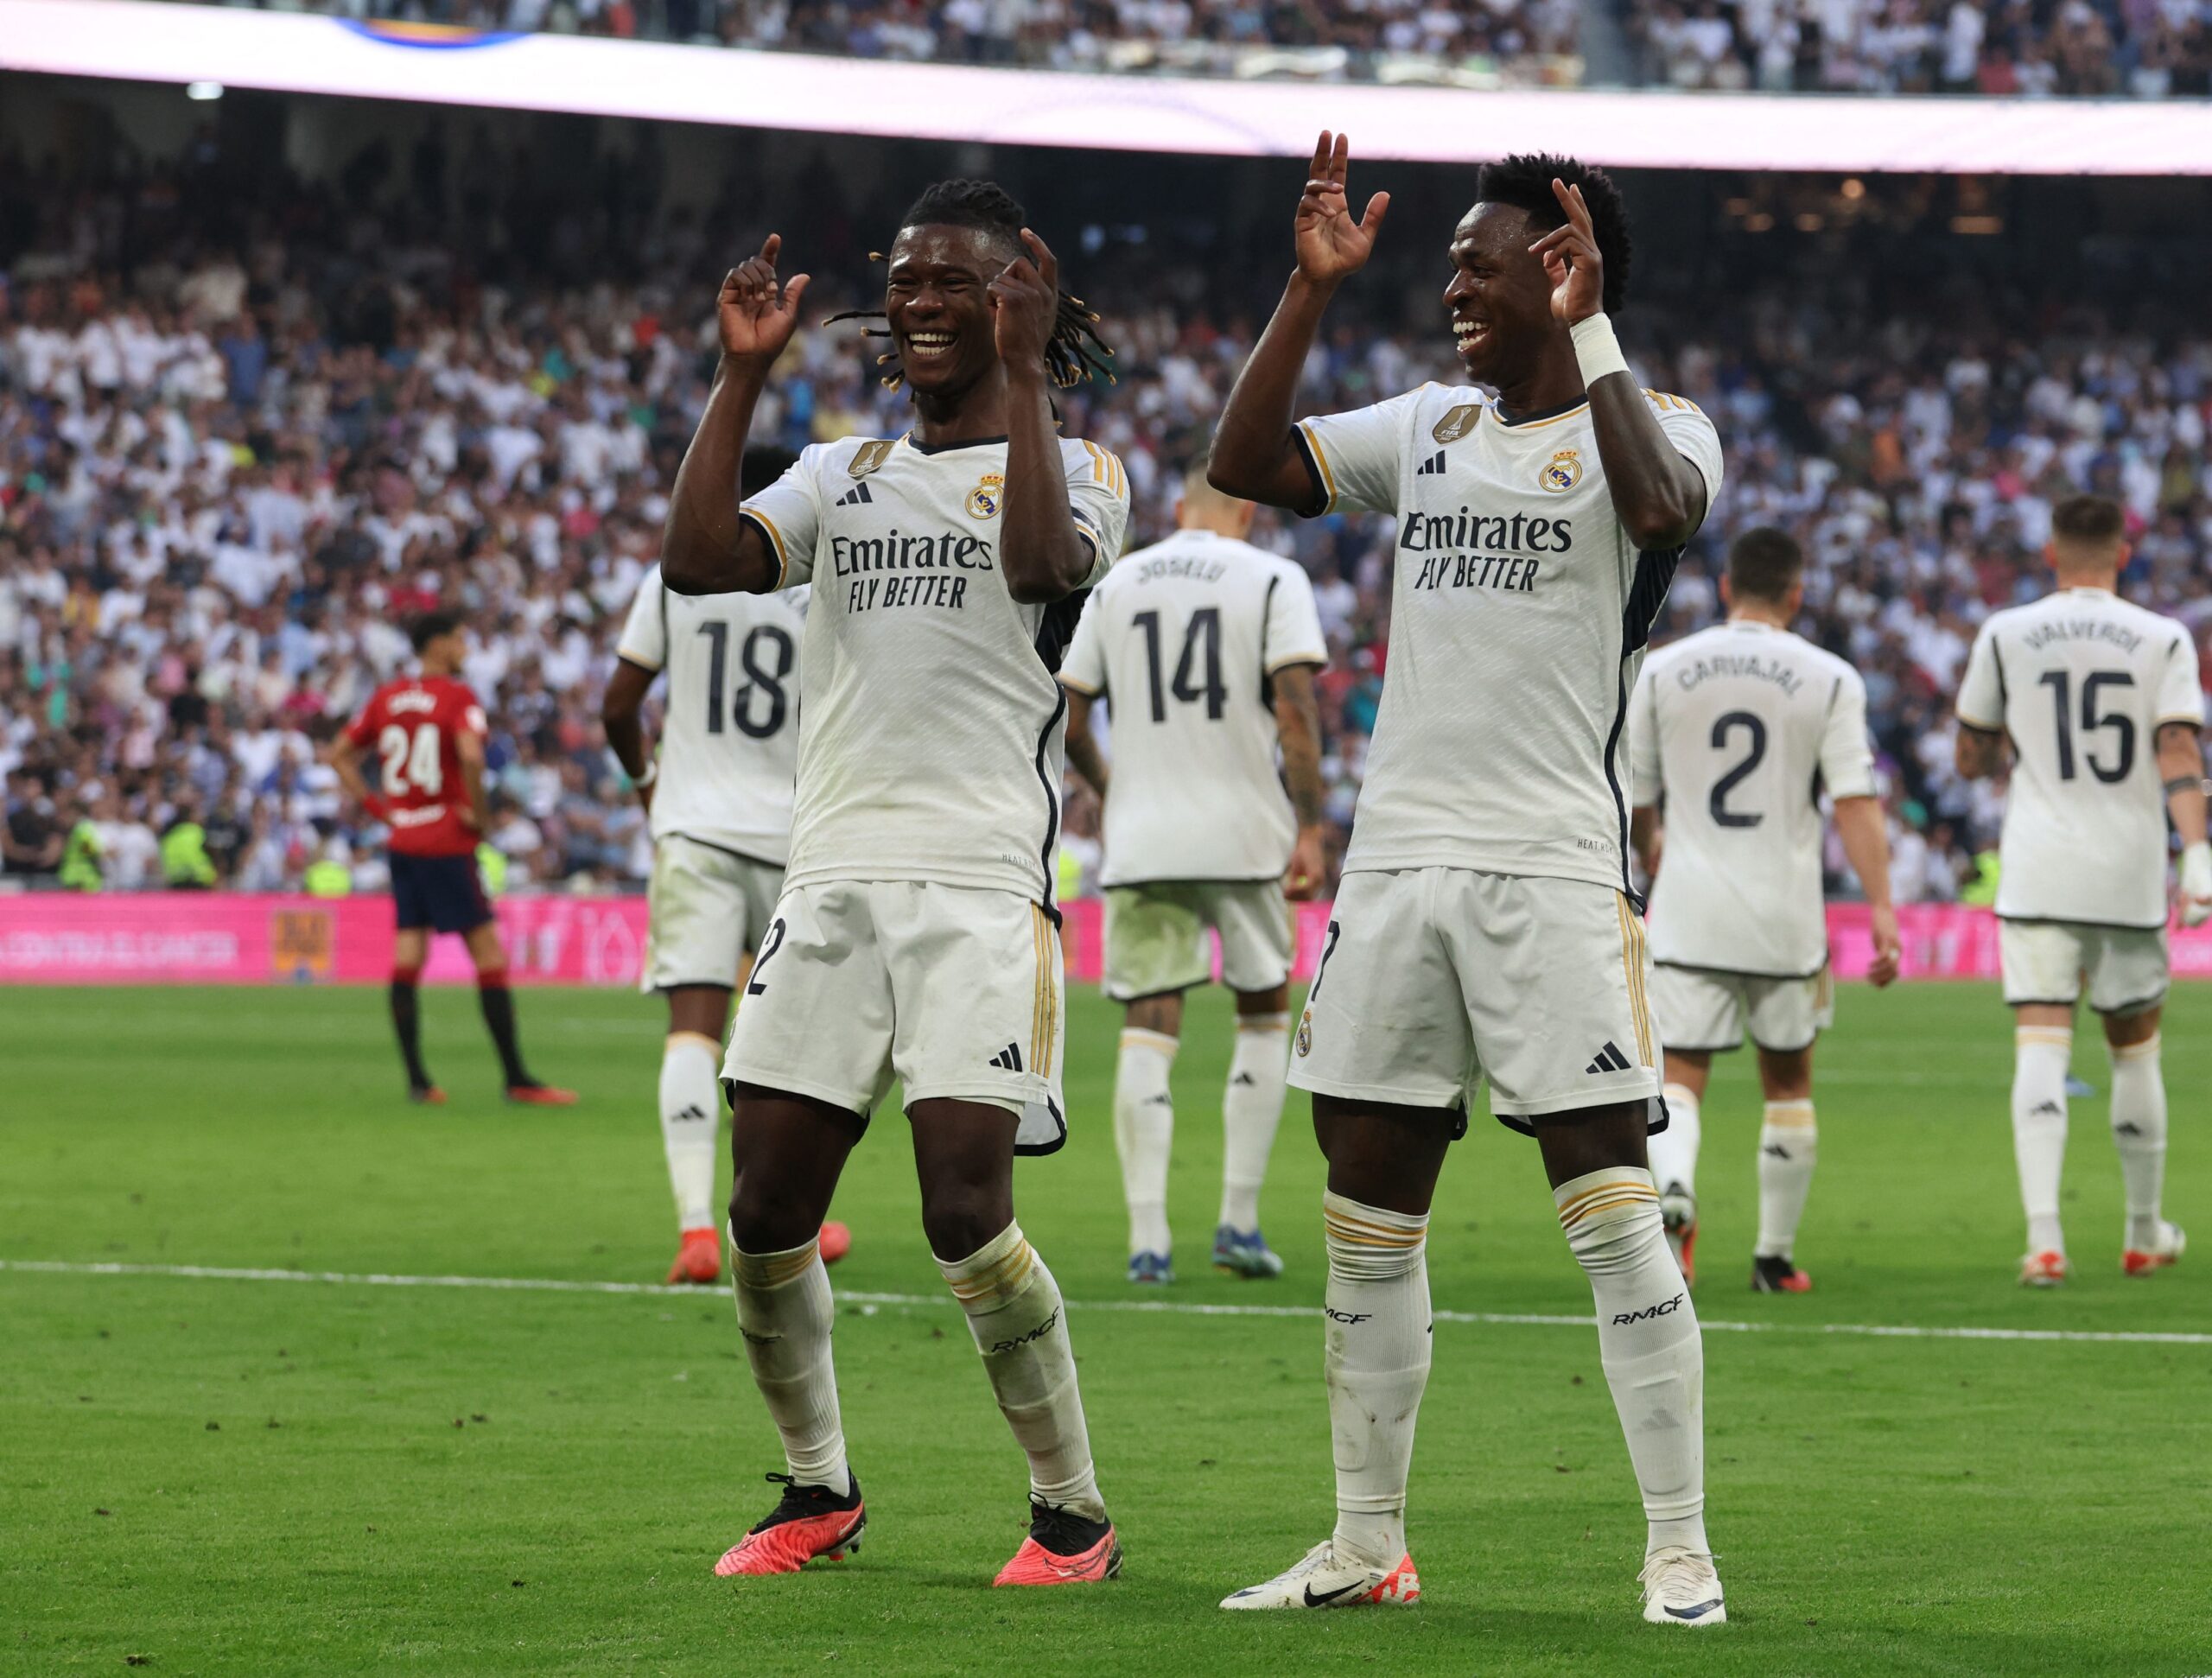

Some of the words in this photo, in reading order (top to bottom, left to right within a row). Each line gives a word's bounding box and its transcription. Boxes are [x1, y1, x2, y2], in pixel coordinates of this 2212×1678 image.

[831, 529, 994, 577] Emirates
[1400, 505, 1572, 553] Emirates
[849, 578, 880, 613] FLY
[882, 575, 967, 609] BETTER
[1414, 556, 1452, 590] FLY
[1452, 555, 1540, 592] BETTER
[697, 621, 794, 740] 18
[1131, 607, 1229, 723] 14
[2039, 671, 2135, 783] 15
[379, 723, 442, 797] 24
[1710, 711, 1767, 827] 2
[1612, 1293, 1684, 1325] RMCF
